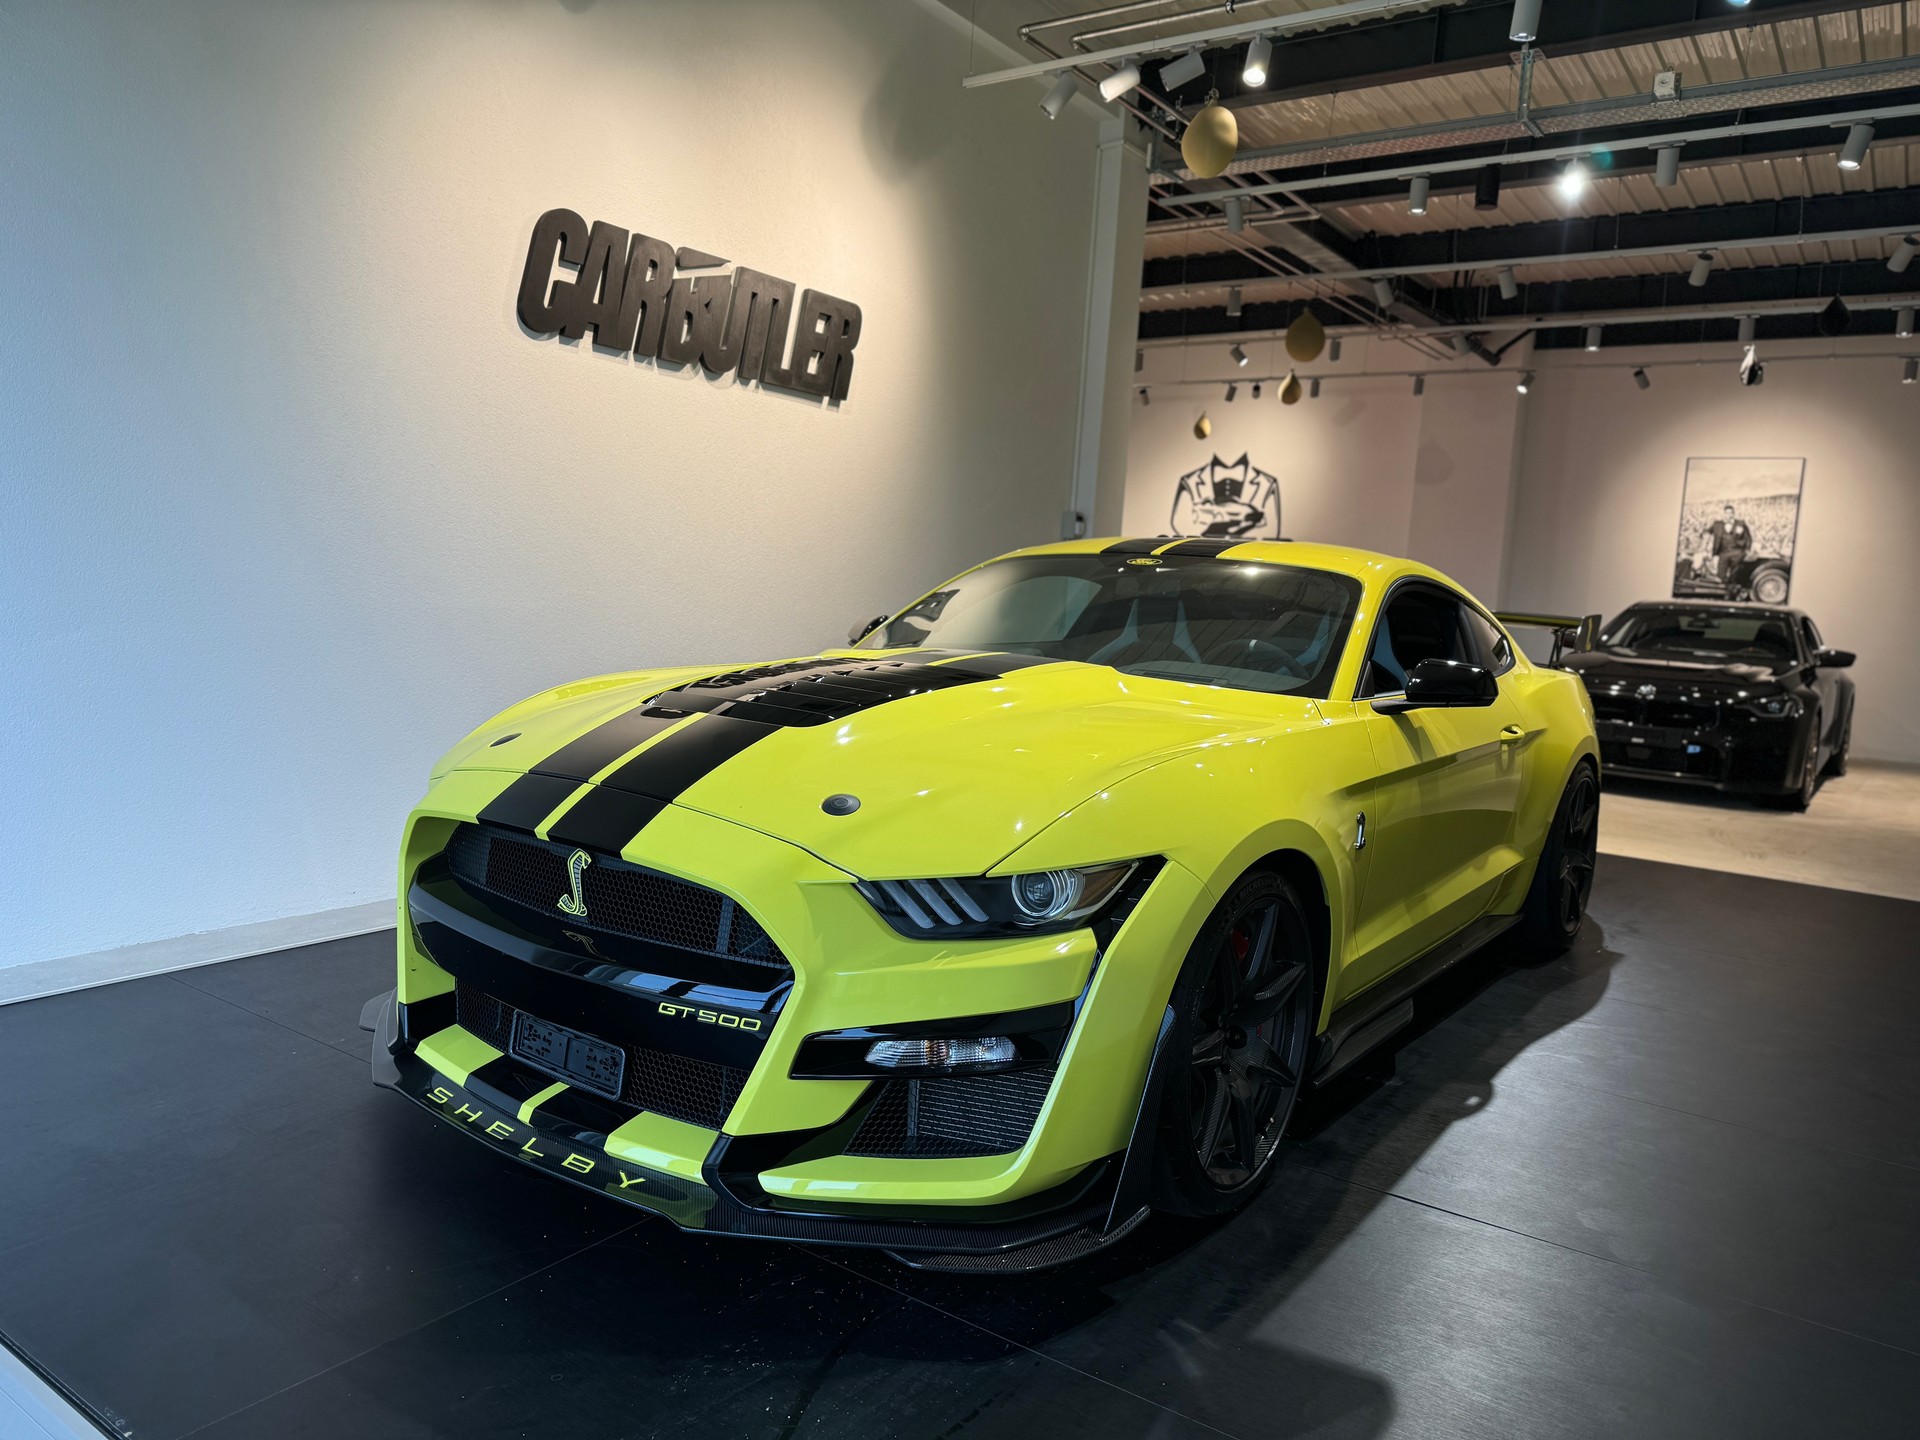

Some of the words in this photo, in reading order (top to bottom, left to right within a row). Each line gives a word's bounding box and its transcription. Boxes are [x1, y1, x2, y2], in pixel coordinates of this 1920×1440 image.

[517, 208, 862, 401] CARBUTLER
[658, 1002, 761, 1031] GT500
[426, 1086, 646, 1188] SHELBY
